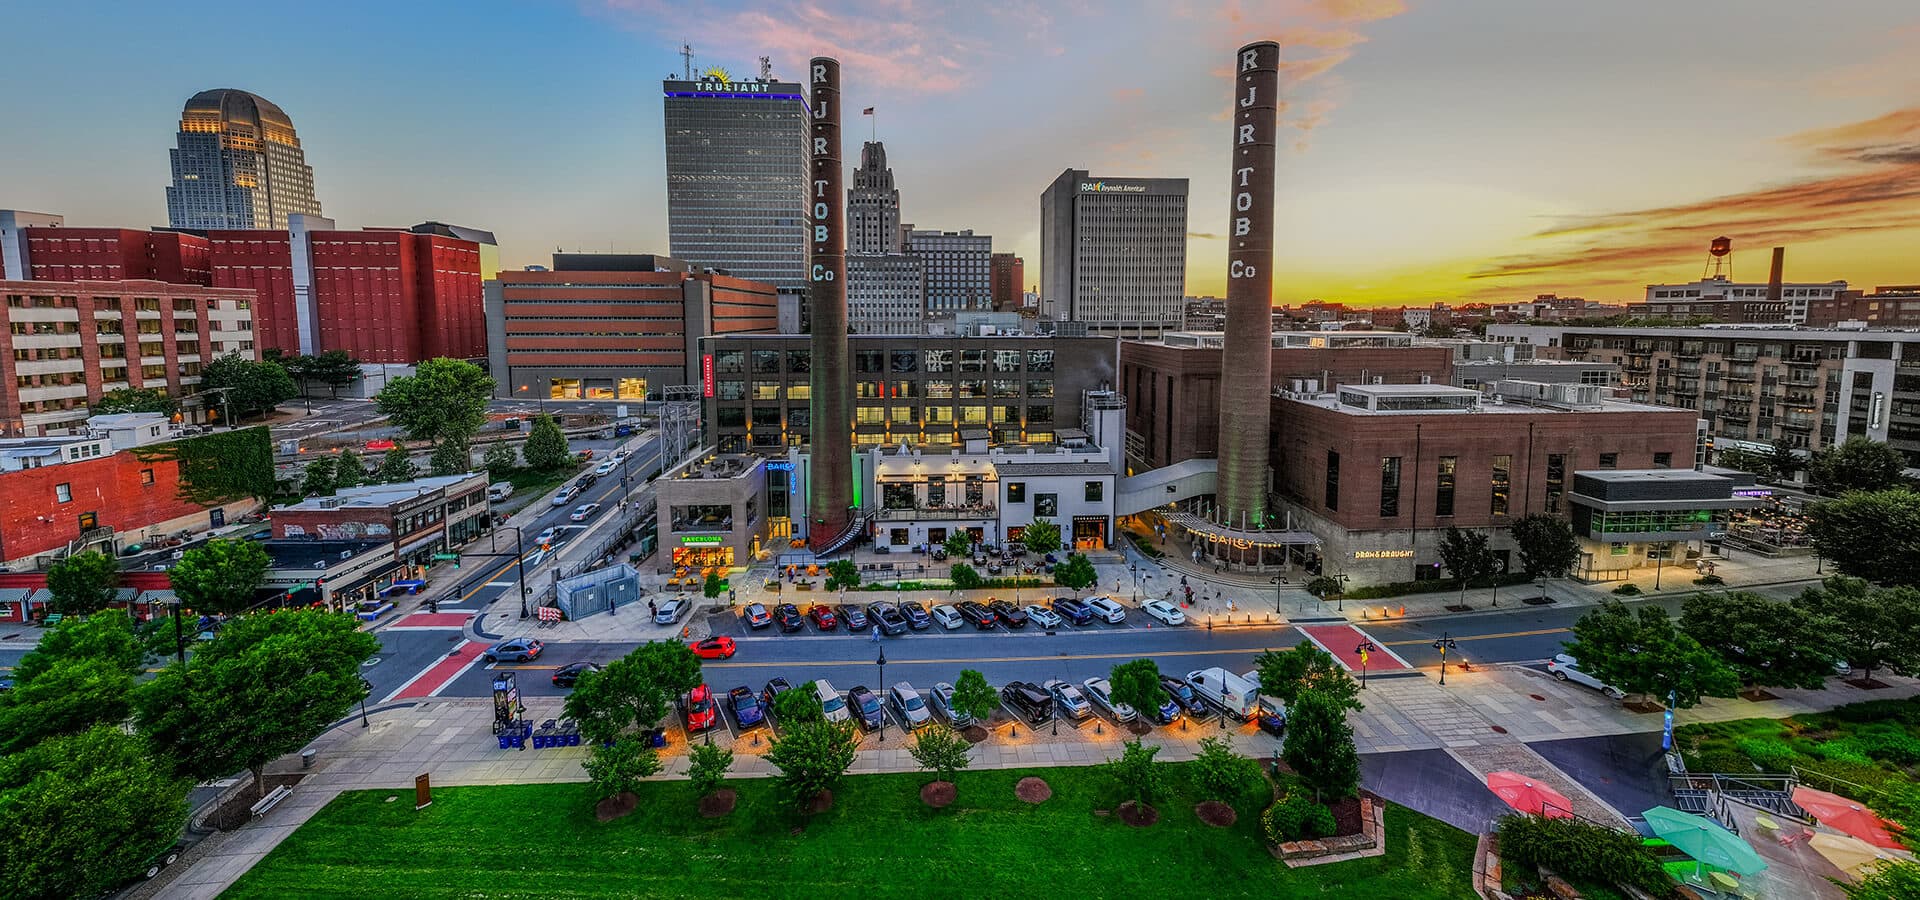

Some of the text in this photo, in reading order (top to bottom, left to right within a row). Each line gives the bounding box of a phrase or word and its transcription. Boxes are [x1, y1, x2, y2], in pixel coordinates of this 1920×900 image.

[695, 82, 769, 92] TRULIANT
[767, 463, 796, 471] BAILEY
[1208, 532, 1255, 550] BAILEY
